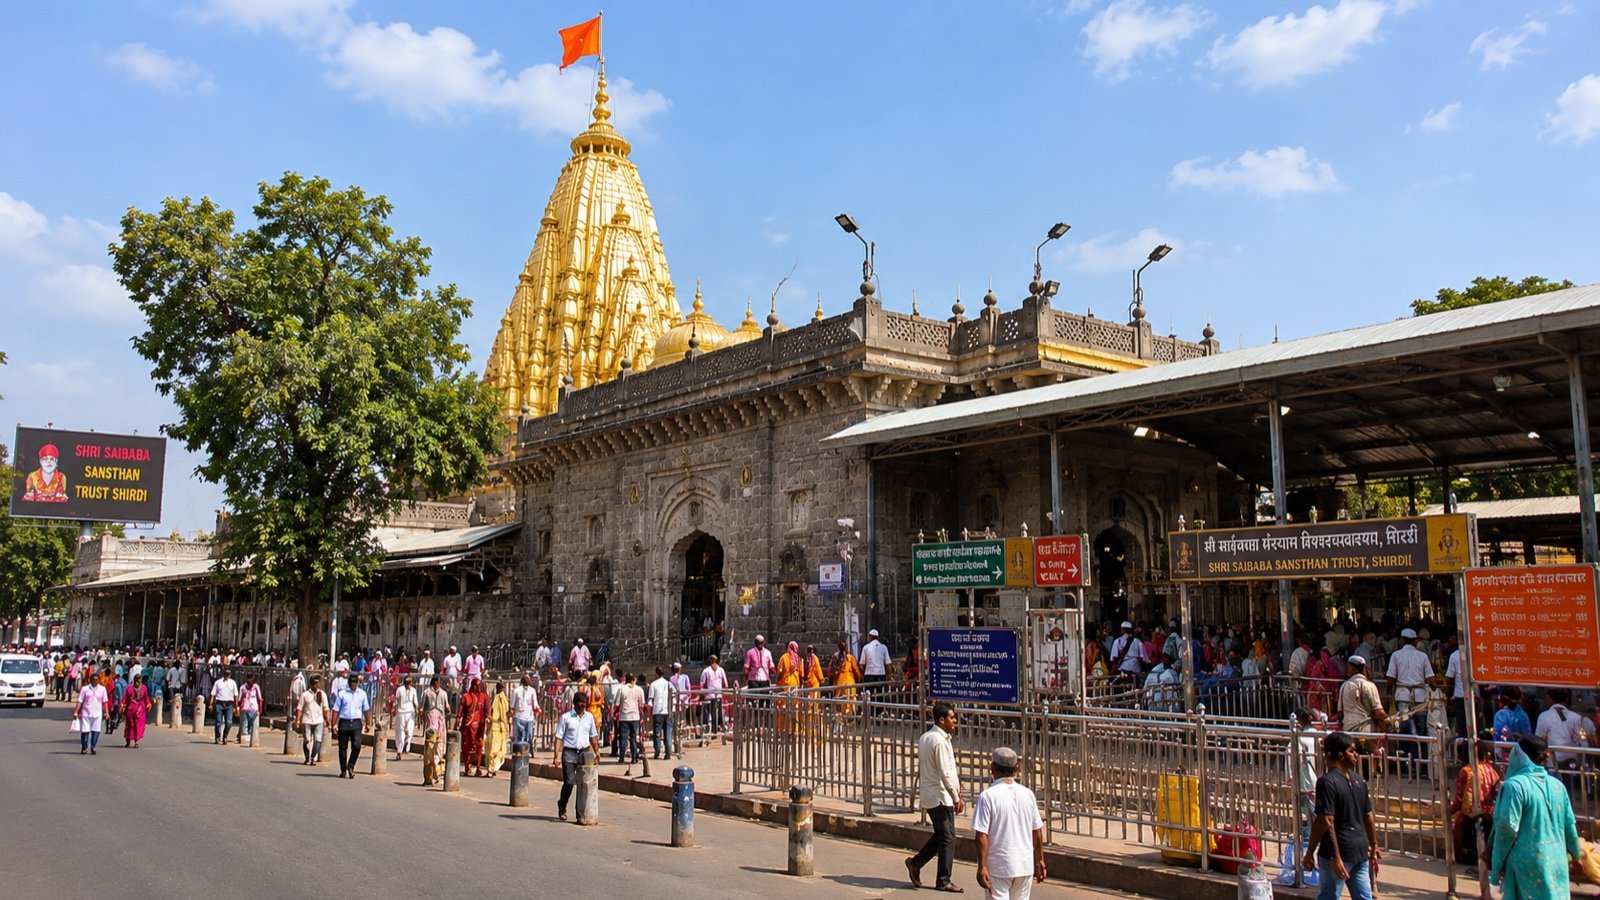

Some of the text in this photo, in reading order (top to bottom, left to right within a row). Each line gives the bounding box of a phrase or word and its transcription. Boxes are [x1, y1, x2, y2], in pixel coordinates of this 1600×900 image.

[75, 444, 151, 462] SHRI SAIBABA
[84, 465, 140, 481] SANSTHAN
[75, 485, 148, 502] TRUST SHIRDI
[1208, 562, 1230, 573] SHRI
[1232, 560, 1273, 572] SAIBABA
[1275, 558, 1329, 570] SANSTHAN
[1331, 556, 1369, 570] TRUST,
